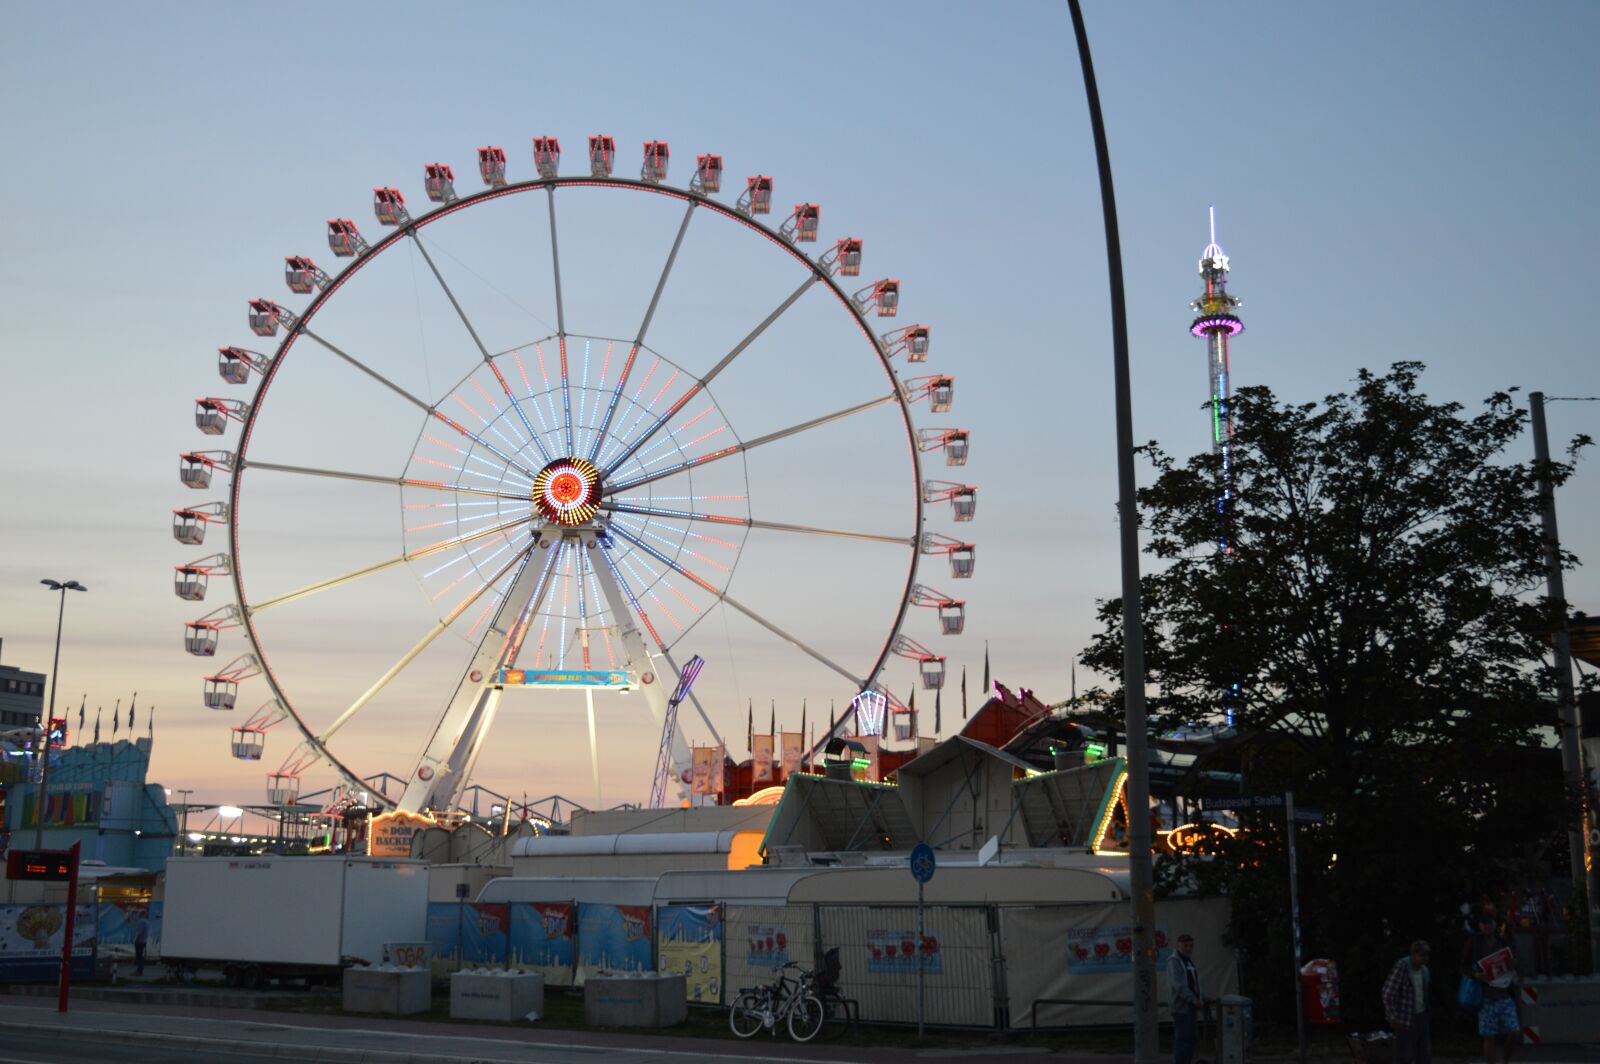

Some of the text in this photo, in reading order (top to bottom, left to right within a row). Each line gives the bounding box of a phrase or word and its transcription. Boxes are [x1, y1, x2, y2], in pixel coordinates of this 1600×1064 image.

[1204, 795, 1282, 809] Budapester Straße
[390, 826, 412, 835] DOM
